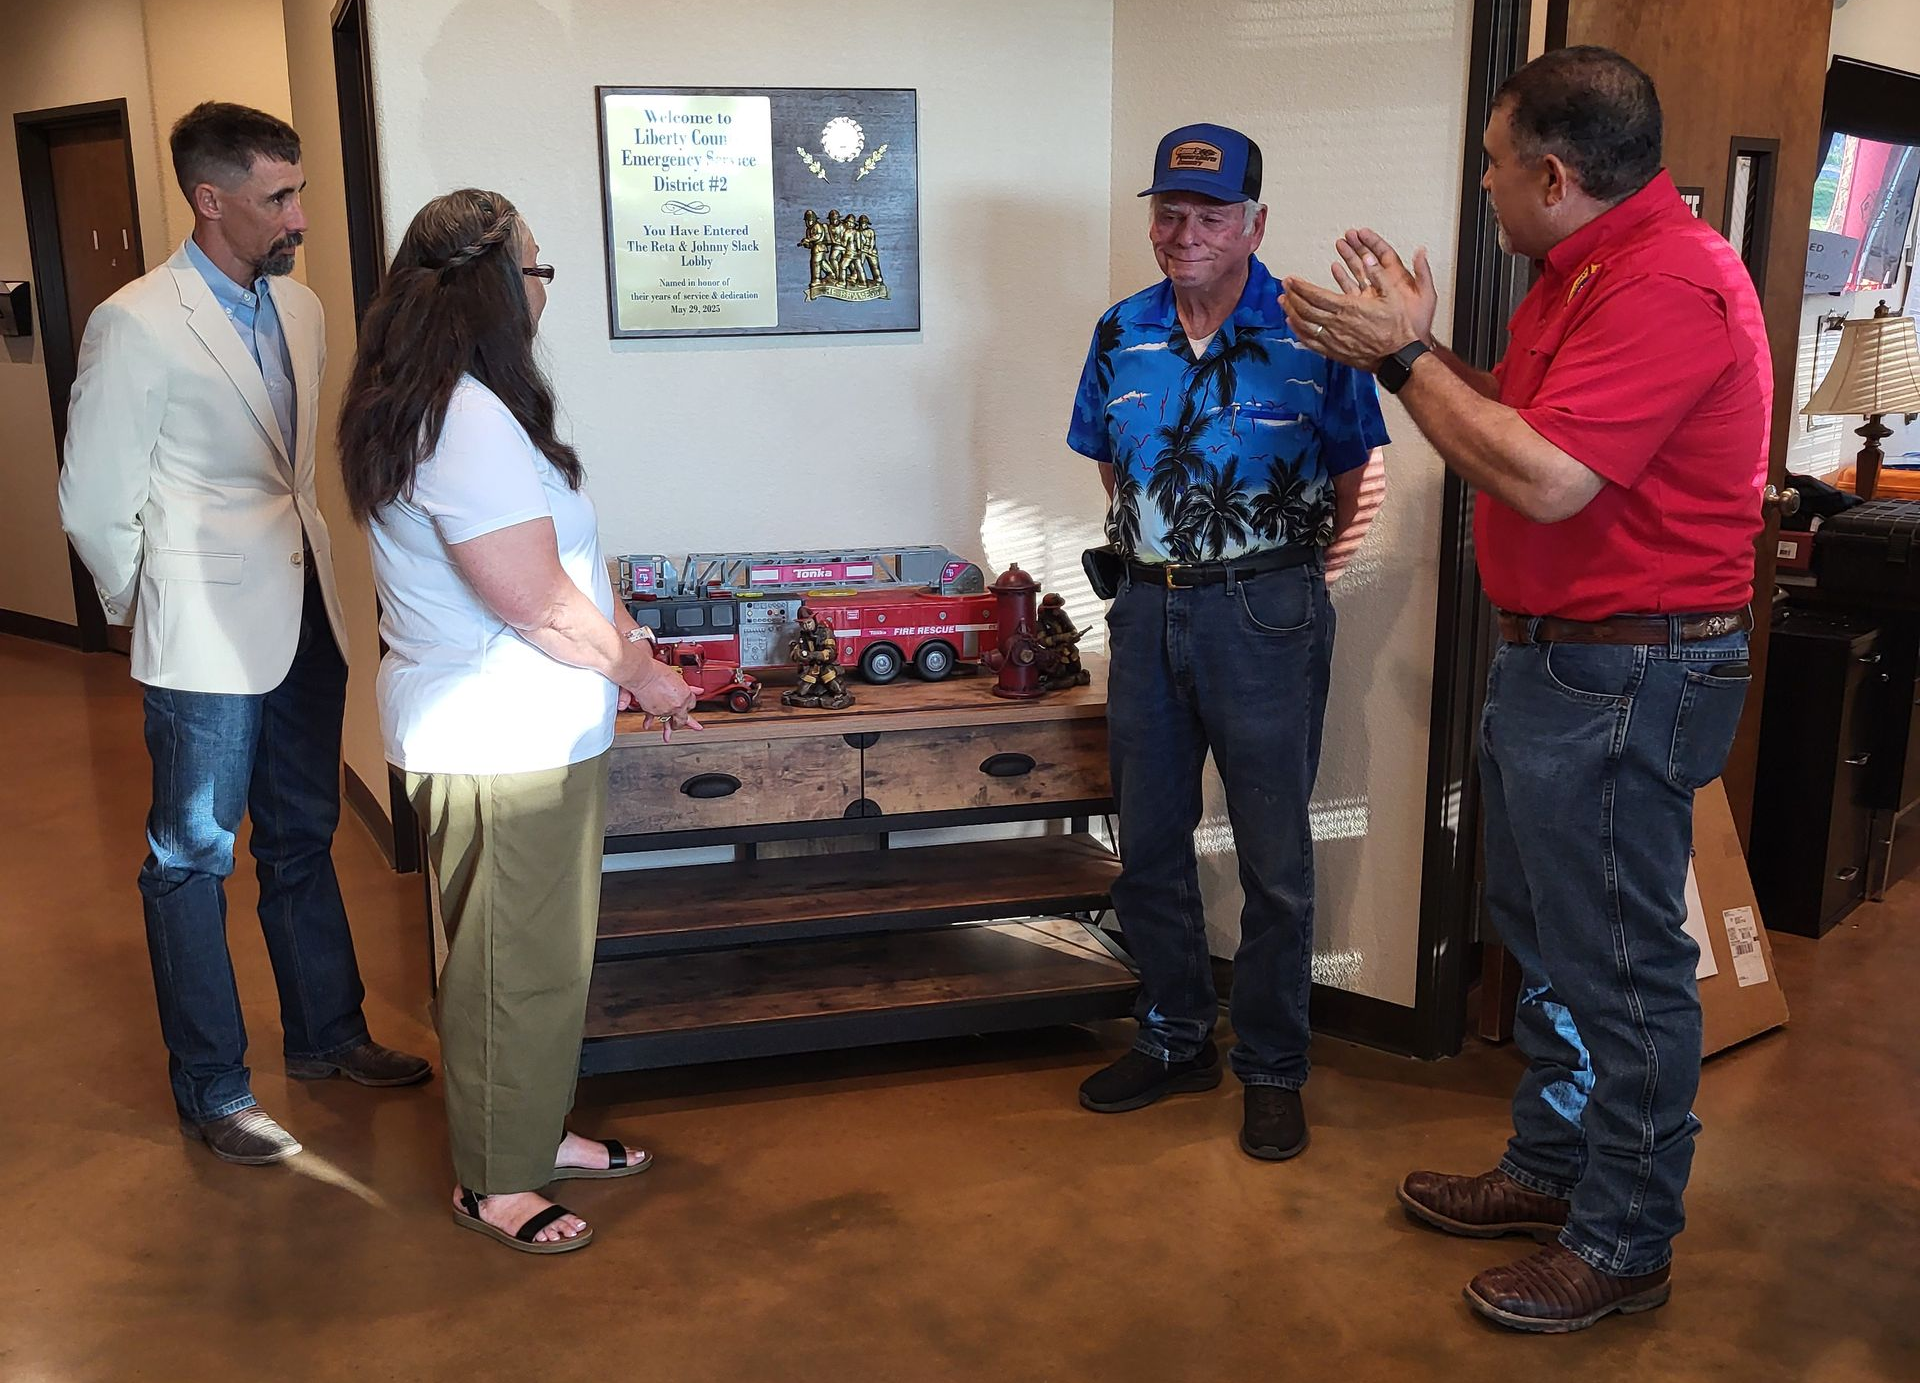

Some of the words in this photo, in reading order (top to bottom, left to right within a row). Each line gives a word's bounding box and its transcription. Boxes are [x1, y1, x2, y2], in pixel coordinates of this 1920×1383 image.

[717, 112, 732, 125] to
[633, 127, 687, 150] Liberty
[691, 128, 728, 146] Coun
[621, 149, 702, 172] Emergency
[706, 150, 757, 167] Sice
[653, 175, 705, 192] District
[708, 175, 728, 193] #2
[643, 224, 666, 237] You
[670, 224, 700, 237] Have
[703, 224, 749, 237] Entered
[627, 240, 648, 253] The
[651, 240, 676, 252] Reta
[678, 241, 688, 252] &
[691, 240, 729, 256] Johnny
[731, 239, 760, 252] Slack
[1809, 242, 1825, 253] ED
[681, 255, 713, 270] Lobby
[659, 278, 686, 288] Named
[688, 278, 696, 287] in
[697, 278, 720, 287] honor
[722, 277, 731, 287] of
[1815, 273, 1830, 281] AID
[630, 291, 650, 301] their
[651, 293, 671, 303] years
[673, 291, 682, 301] of
[683, 292, 710, 301] service
[711, 291, 718, 300] &
[720, 290, 759, 300] dedication
[670, 304, 687, 316] May
[689, 304, 701, 314] 29,
[702, 304, 721, 313] 2025
[792, 567, 832, 579] Tonka
[893, 626, 915, 636] FIRE
[917, 625, 955, 636] RESCUE
